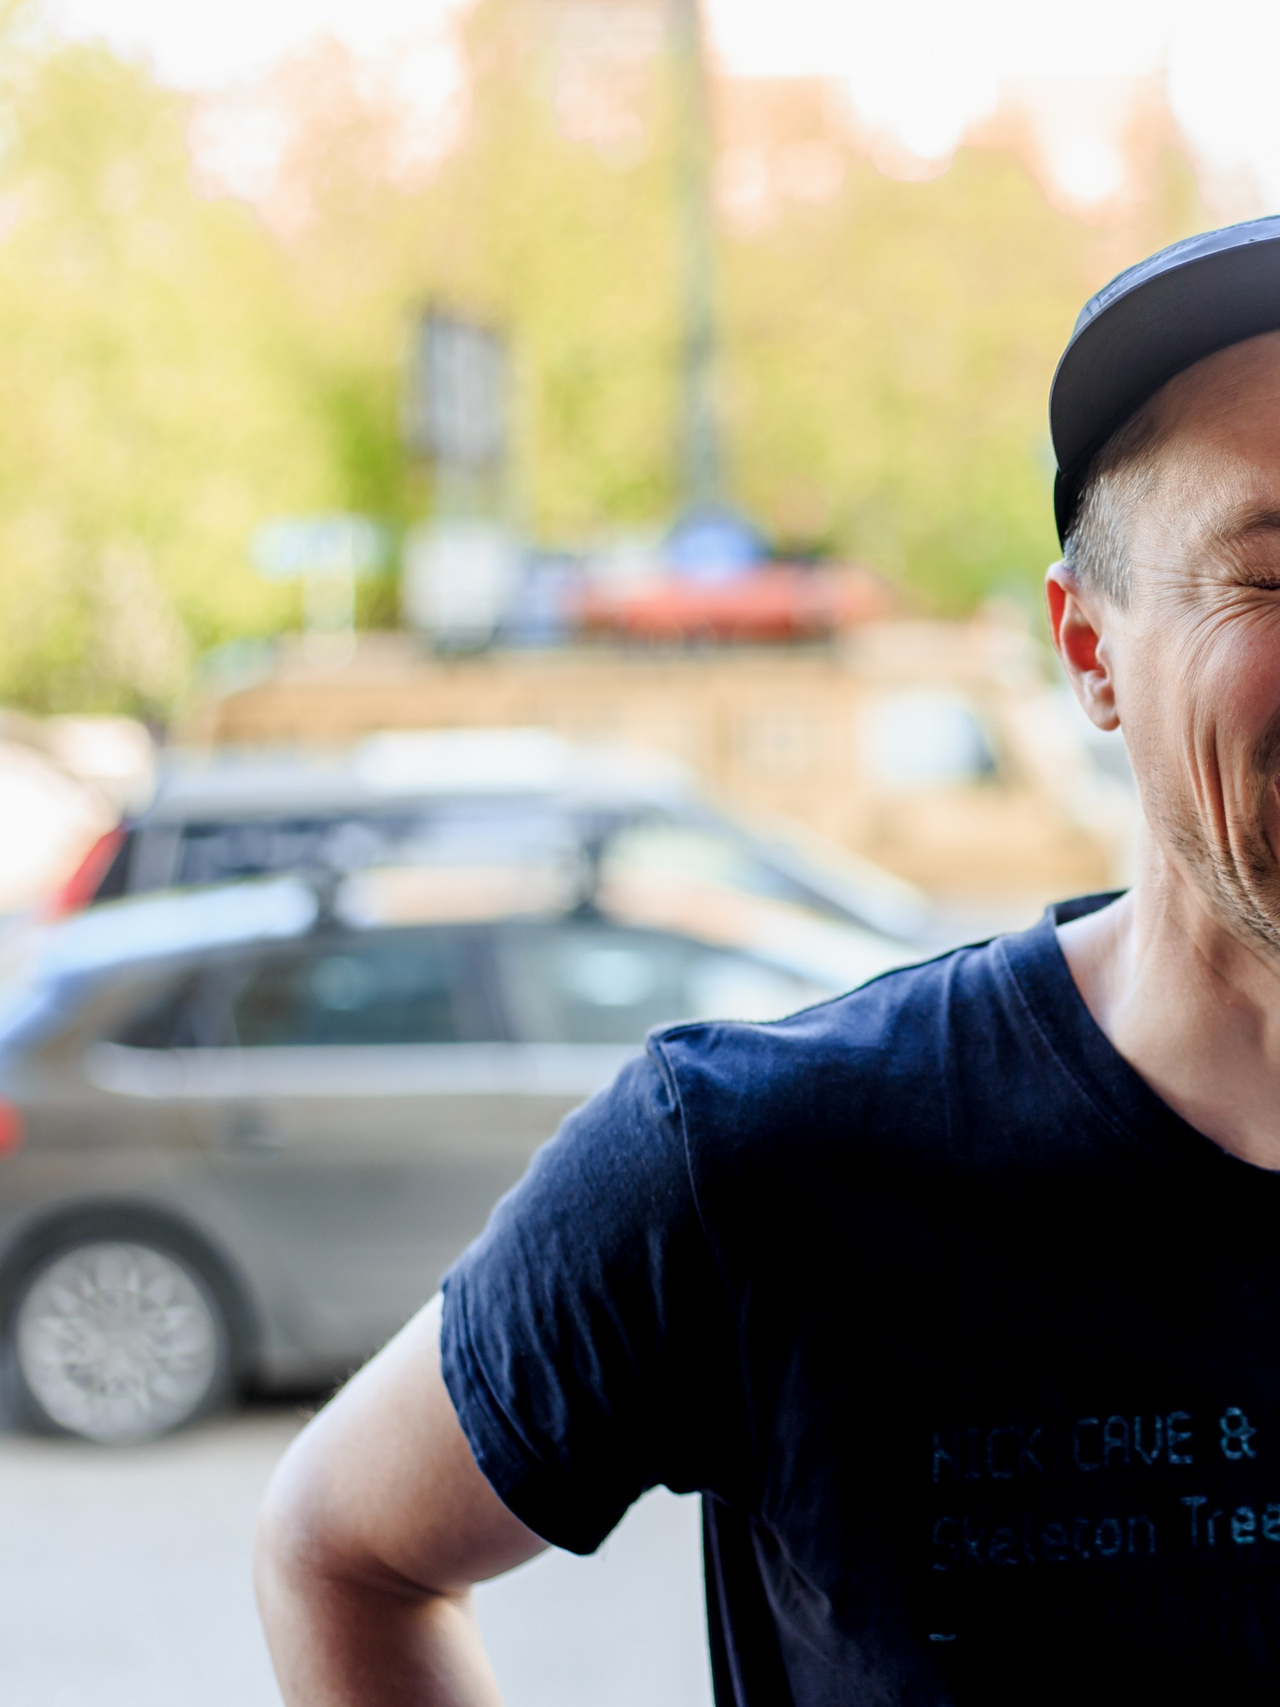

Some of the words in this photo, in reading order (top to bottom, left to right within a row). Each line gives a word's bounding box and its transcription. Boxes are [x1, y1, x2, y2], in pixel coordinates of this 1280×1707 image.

[930, 1420, 1047, 1484] NICK
[1072, 1410, 1195, 1472] CAVE
[1218, 1405, 1258, 1461] &
[930, 1510, 1157, 1572] Skeleton
